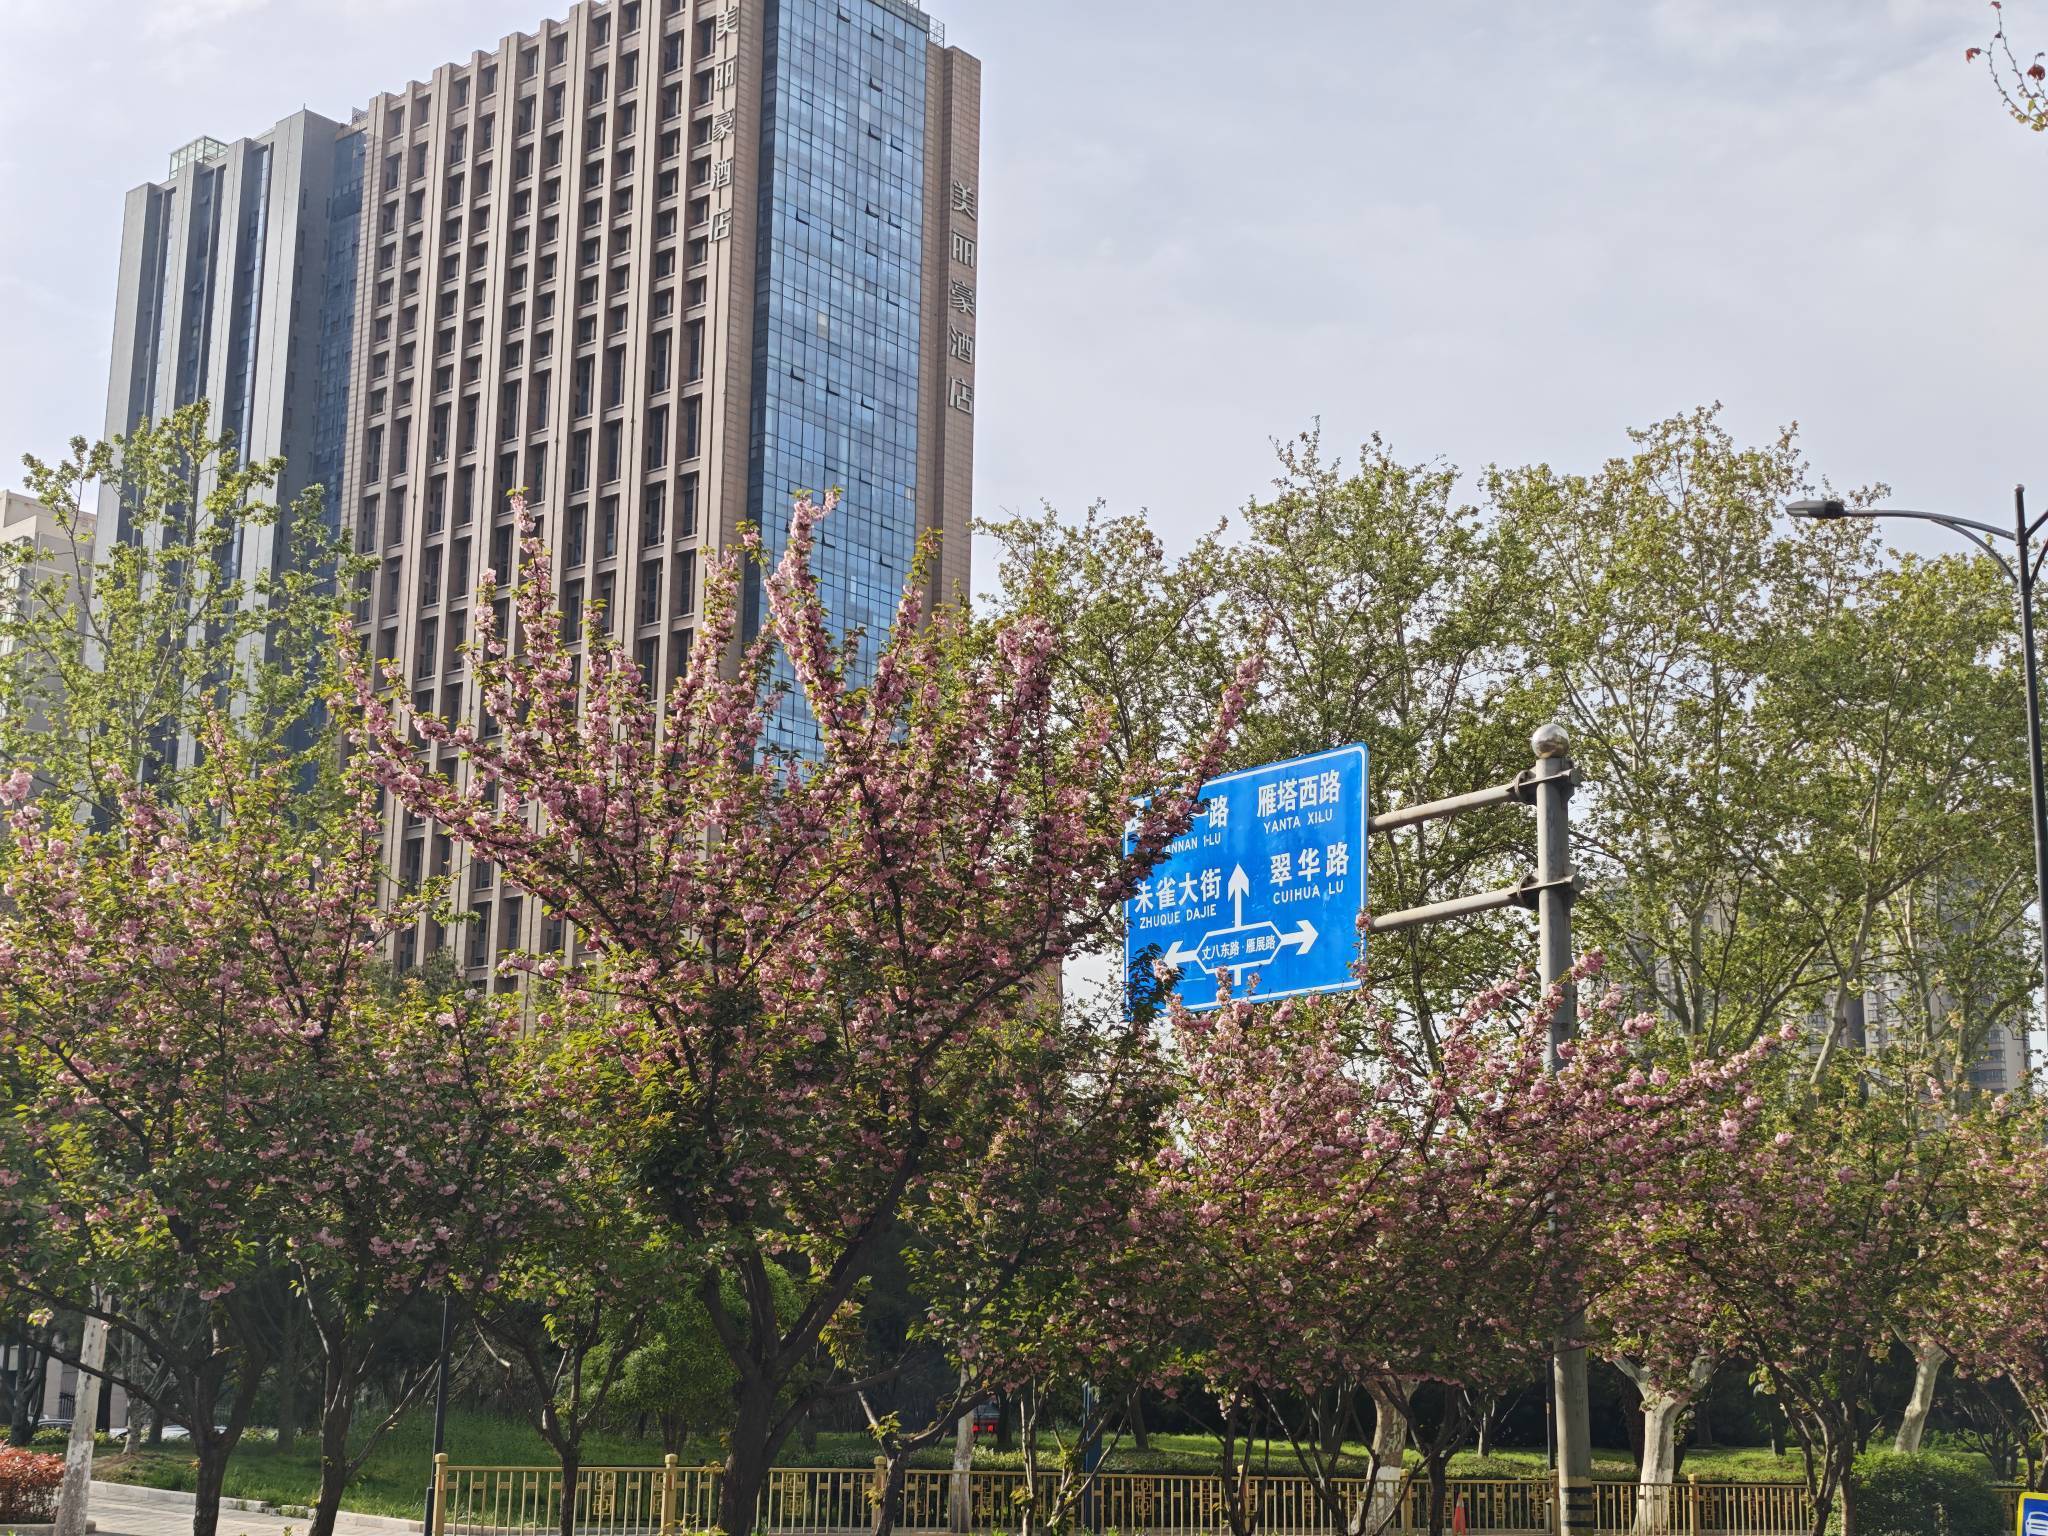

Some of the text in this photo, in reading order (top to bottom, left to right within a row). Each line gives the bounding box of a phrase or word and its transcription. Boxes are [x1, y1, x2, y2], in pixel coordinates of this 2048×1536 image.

[709, 5, 738, 243] 美丽豪酒店
[949, 179, 976, 415] 美丽豪酒店
[1257, 769, 1341, 818] 雁塔西路
[1263, 808, 1333, 835] YANTA XILU
[1163, 836, 1198, 854] ANNAN
[1270, 841, 1350, 887] 翠华路
[1134, 868, 1222, 914] 朱雀大街
[1273, 879, 1344, 905] CUIHUA LU
[1139, 903, 1217, 929] ZHUQUE DAJIE
